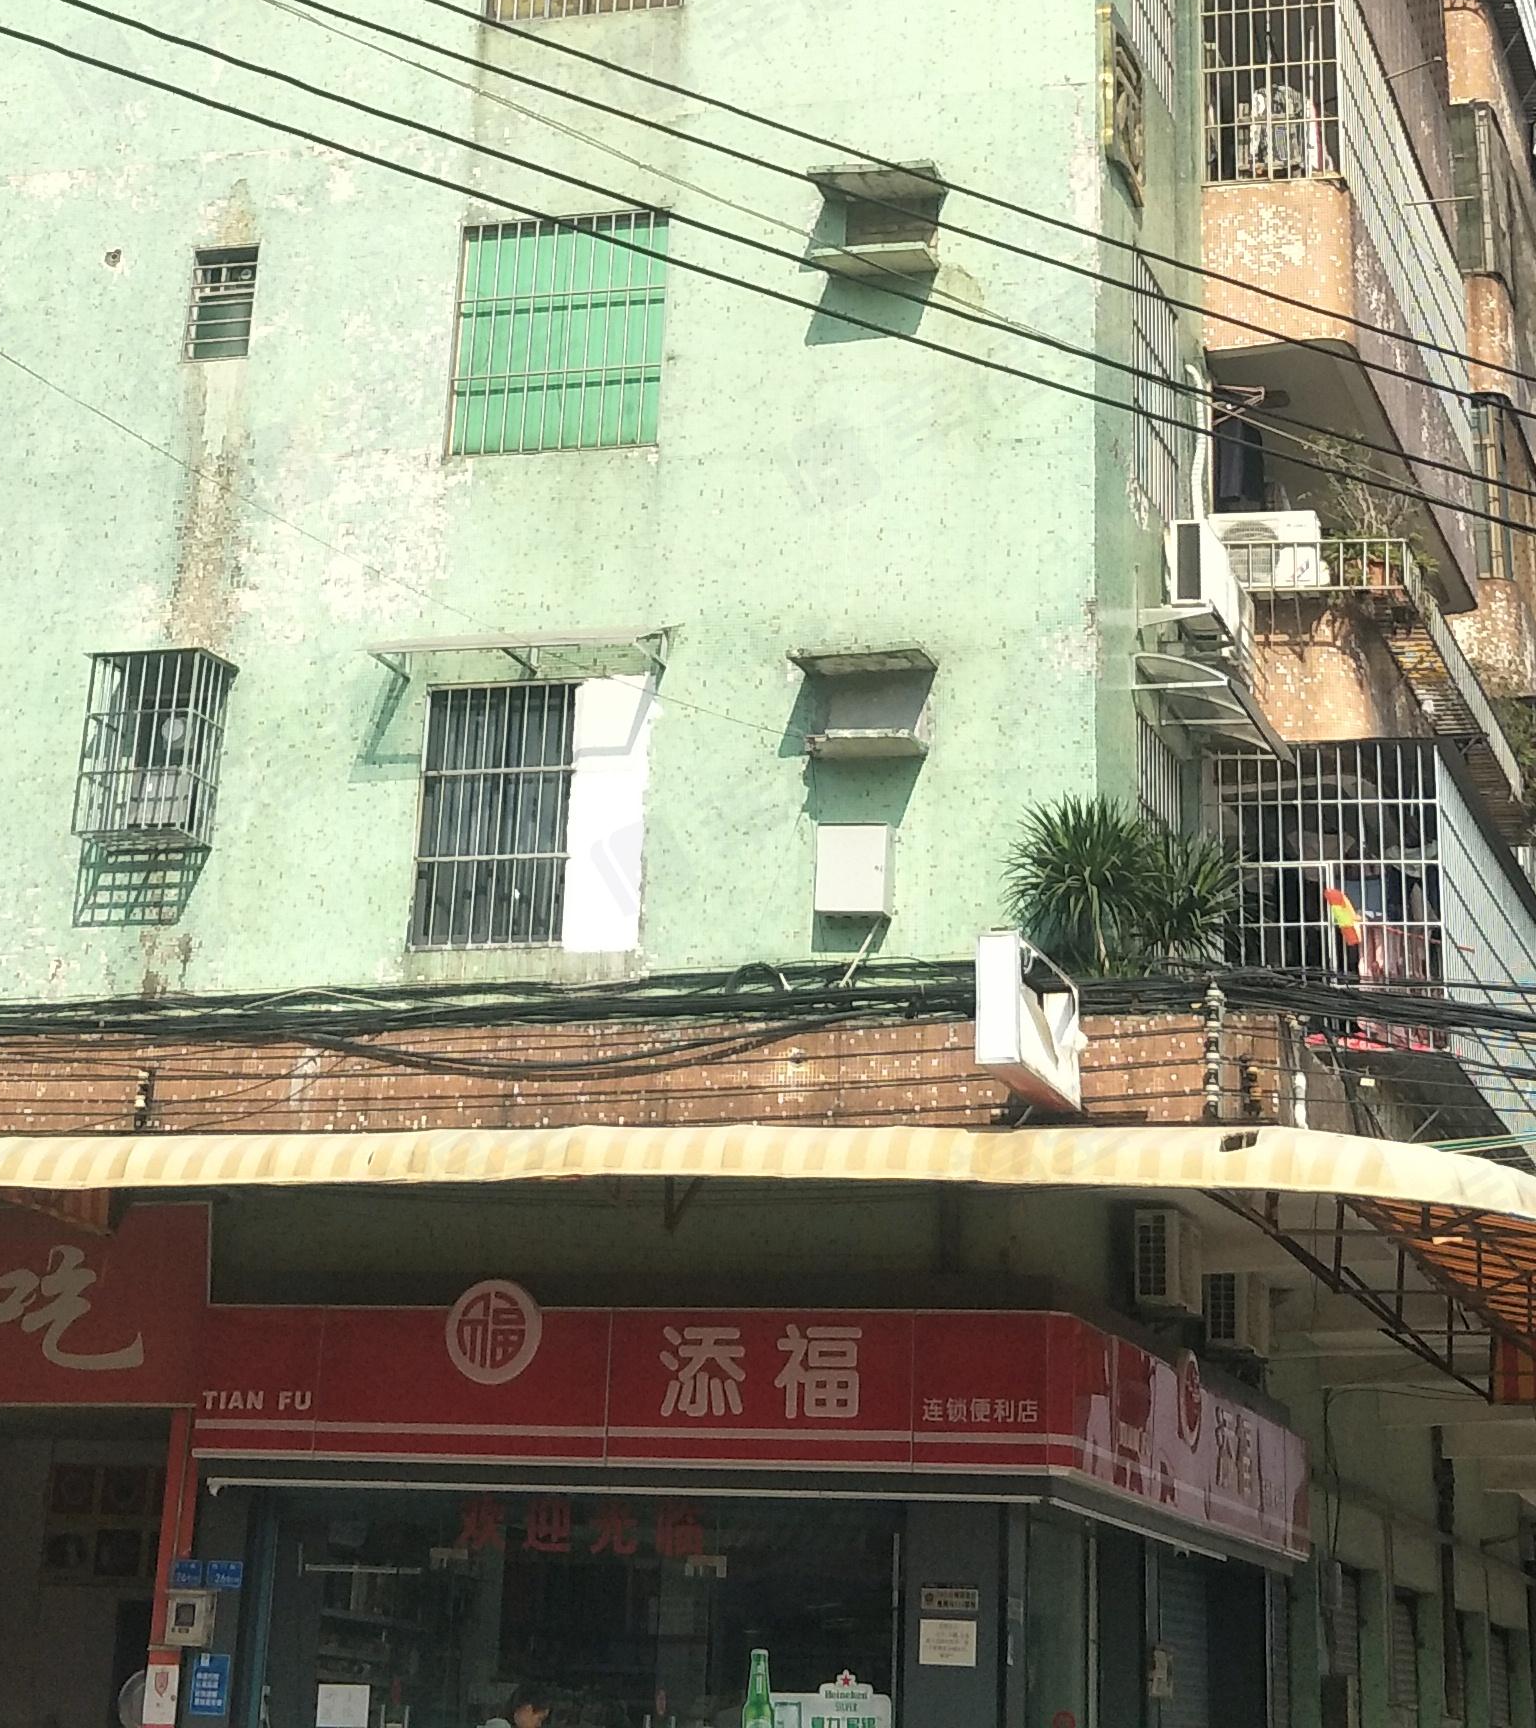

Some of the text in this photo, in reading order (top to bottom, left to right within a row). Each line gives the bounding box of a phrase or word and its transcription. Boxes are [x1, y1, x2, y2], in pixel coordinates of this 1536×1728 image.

[659, 1324, 862, 1420] 添福
[202, 1389, 313, 1411] TIAN FU
[922, 1396, 1039, 1424] 连锁便利店
